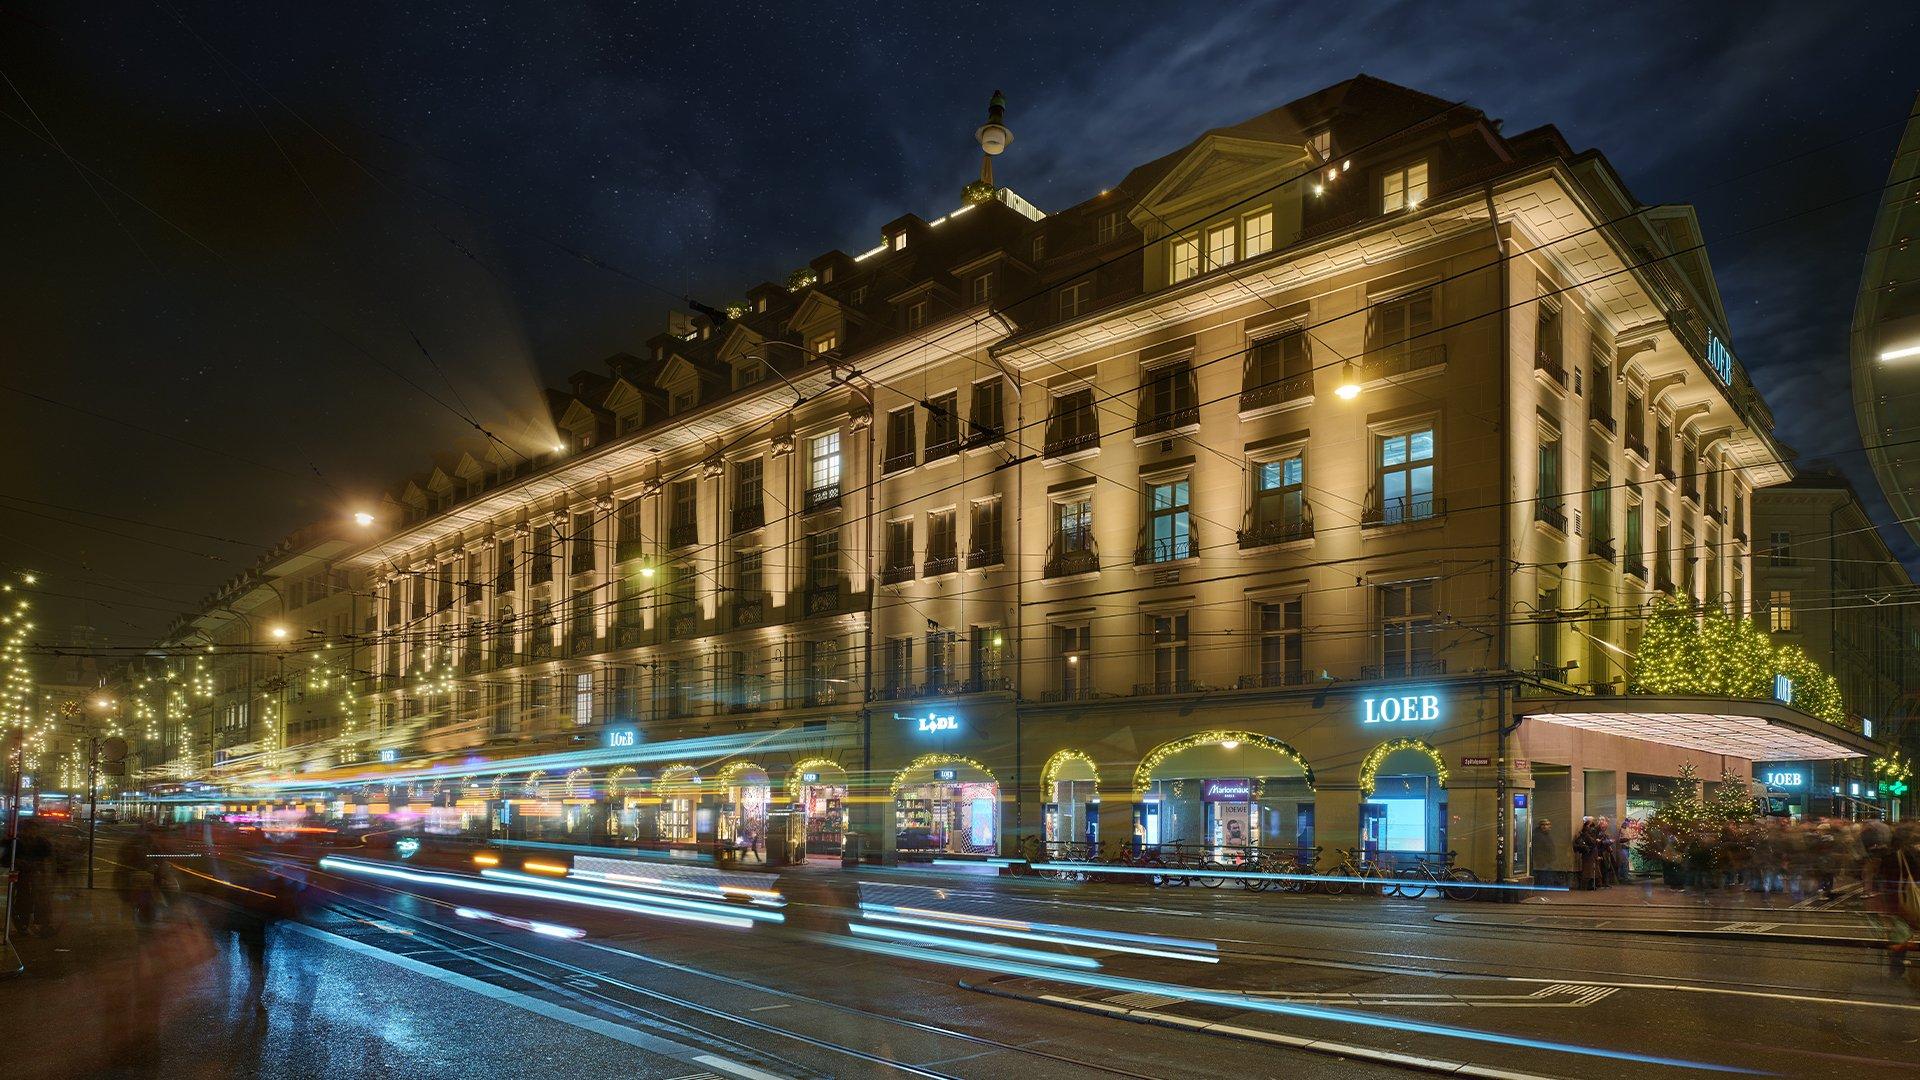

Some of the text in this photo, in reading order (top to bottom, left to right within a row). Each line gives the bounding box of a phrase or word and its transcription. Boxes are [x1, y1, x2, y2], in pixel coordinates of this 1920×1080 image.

[1707, 326, 1731, 386] LOEB
[1364, 695, 1440, 723] LOEB
[610, 731, 634, 746] LOEB
[1767, 773, 1802, 786] LOEB
